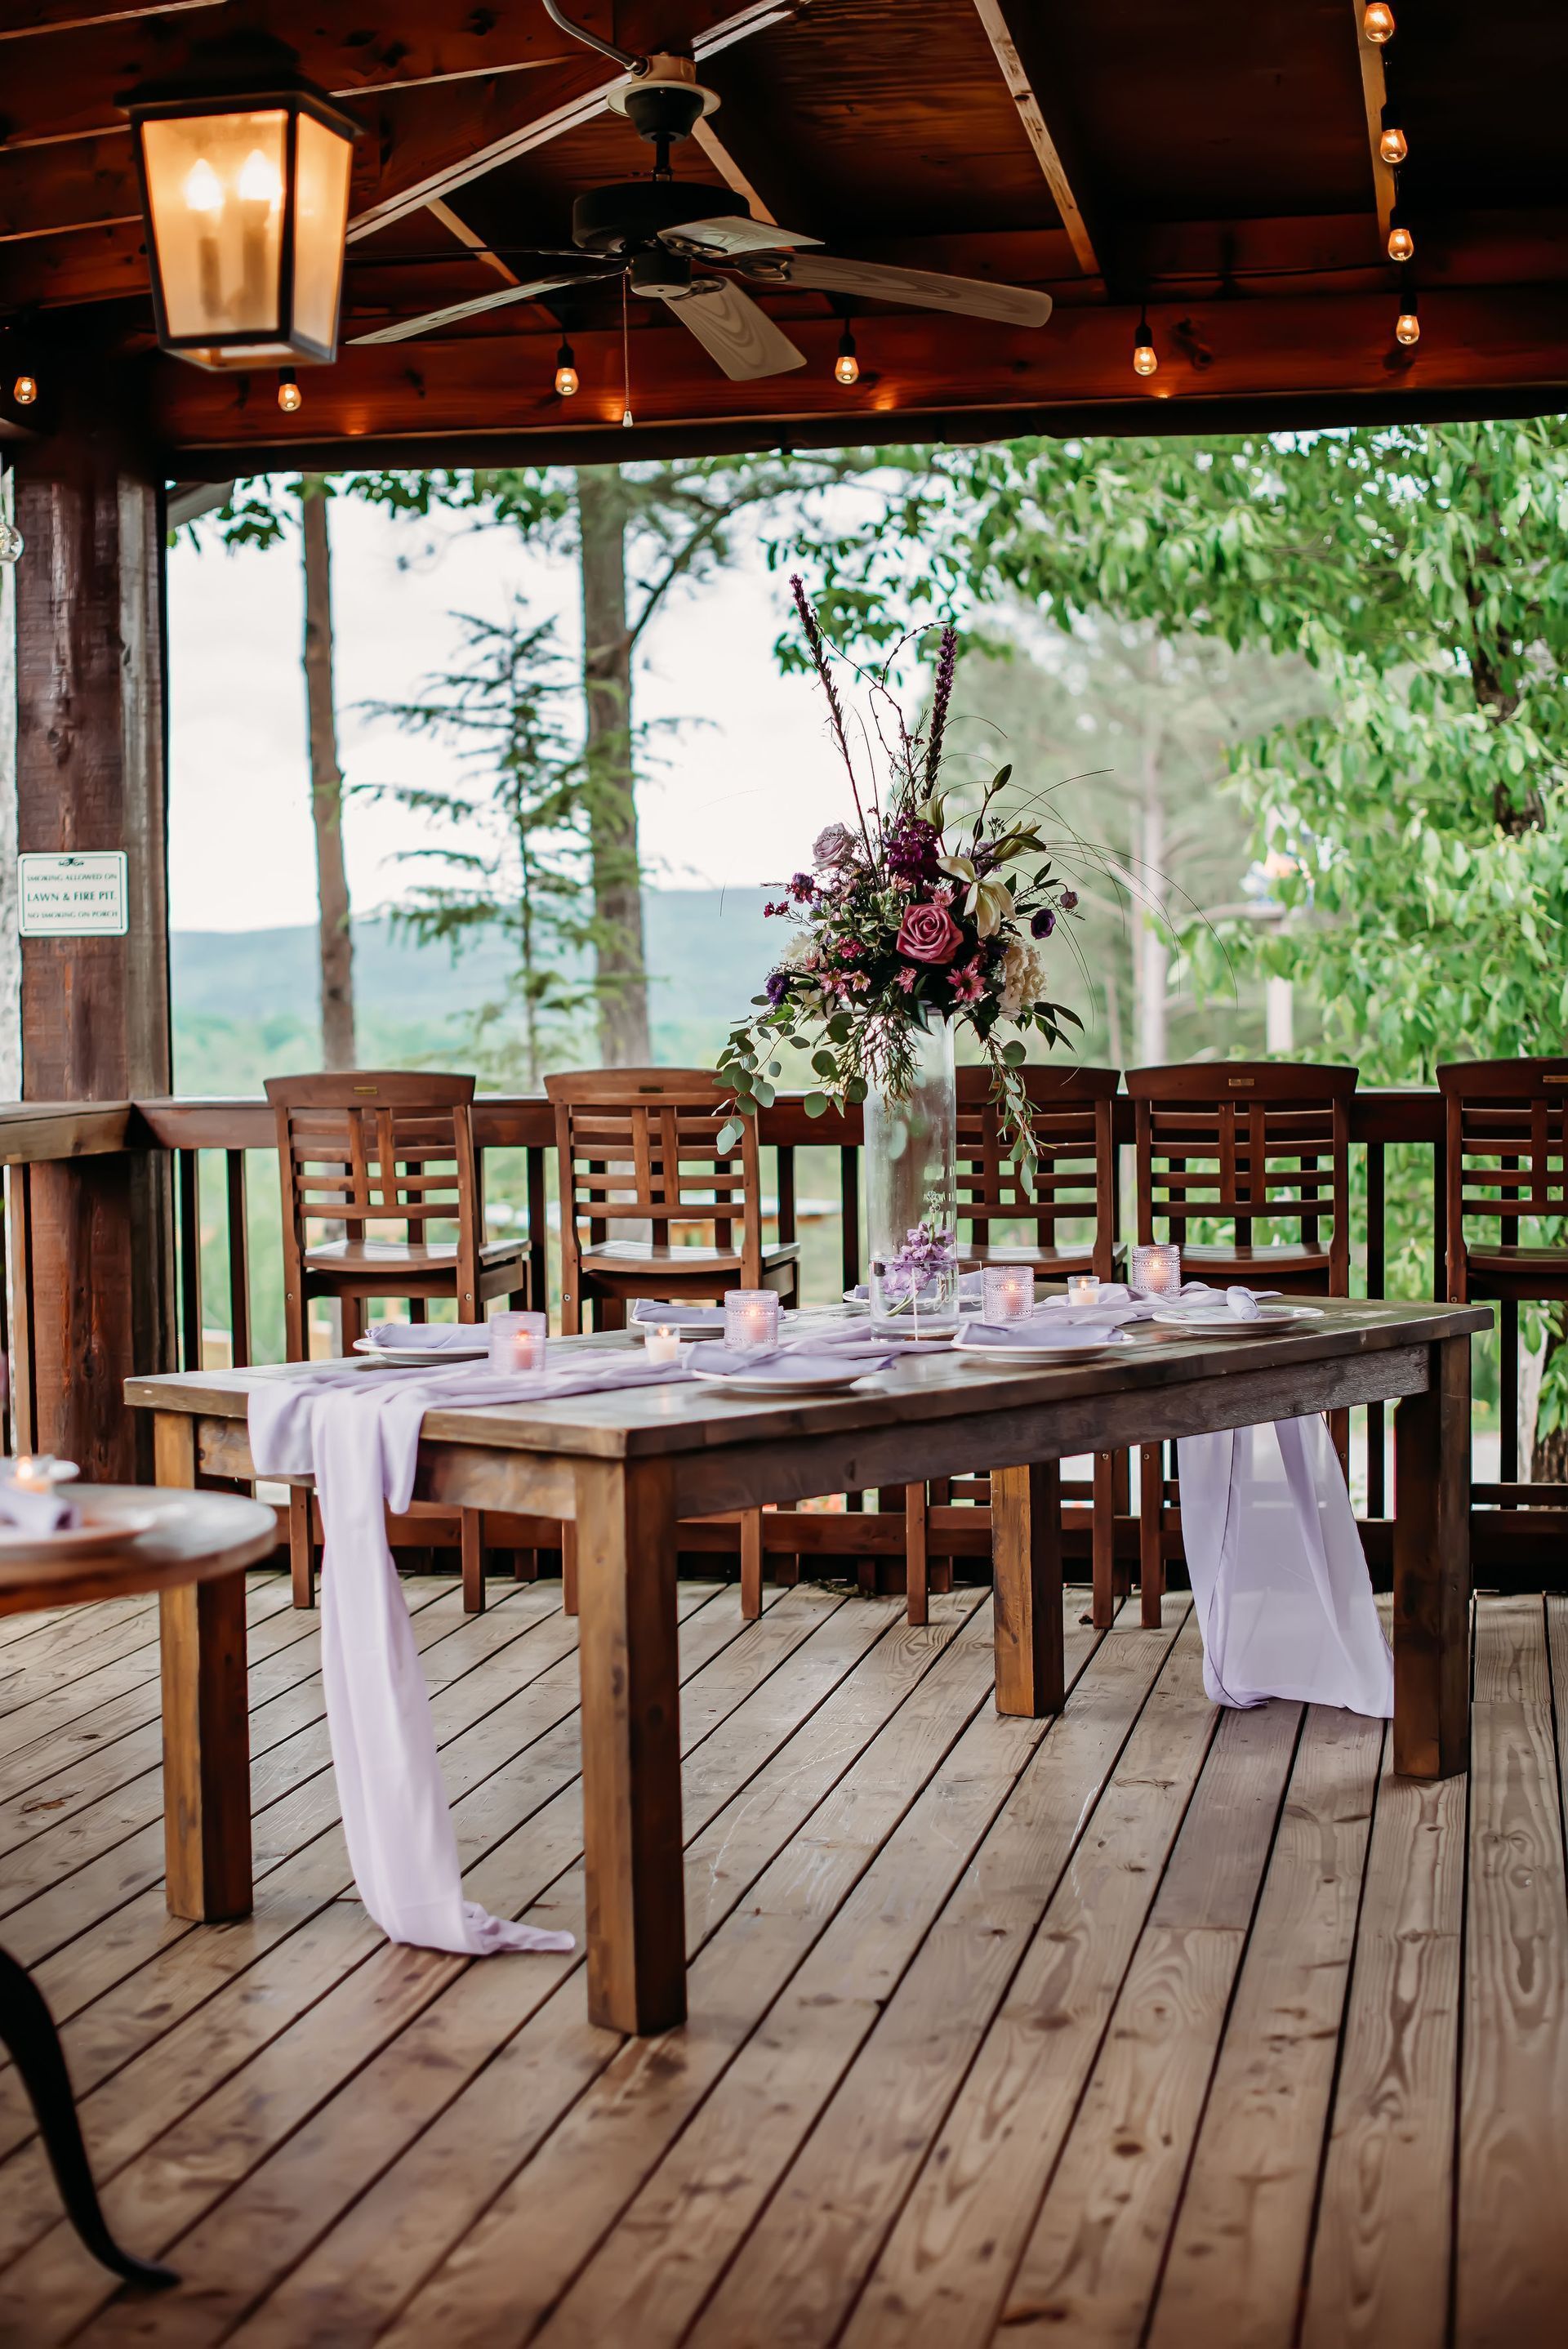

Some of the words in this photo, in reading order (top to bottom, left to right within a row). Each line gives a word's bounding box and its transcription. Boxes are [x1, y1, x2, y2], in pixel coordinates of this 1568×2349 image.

[27, 893, 59, 902] LAWN
[63, 892, 70, 901] &
[74, 891, 94, 901] FIRE
